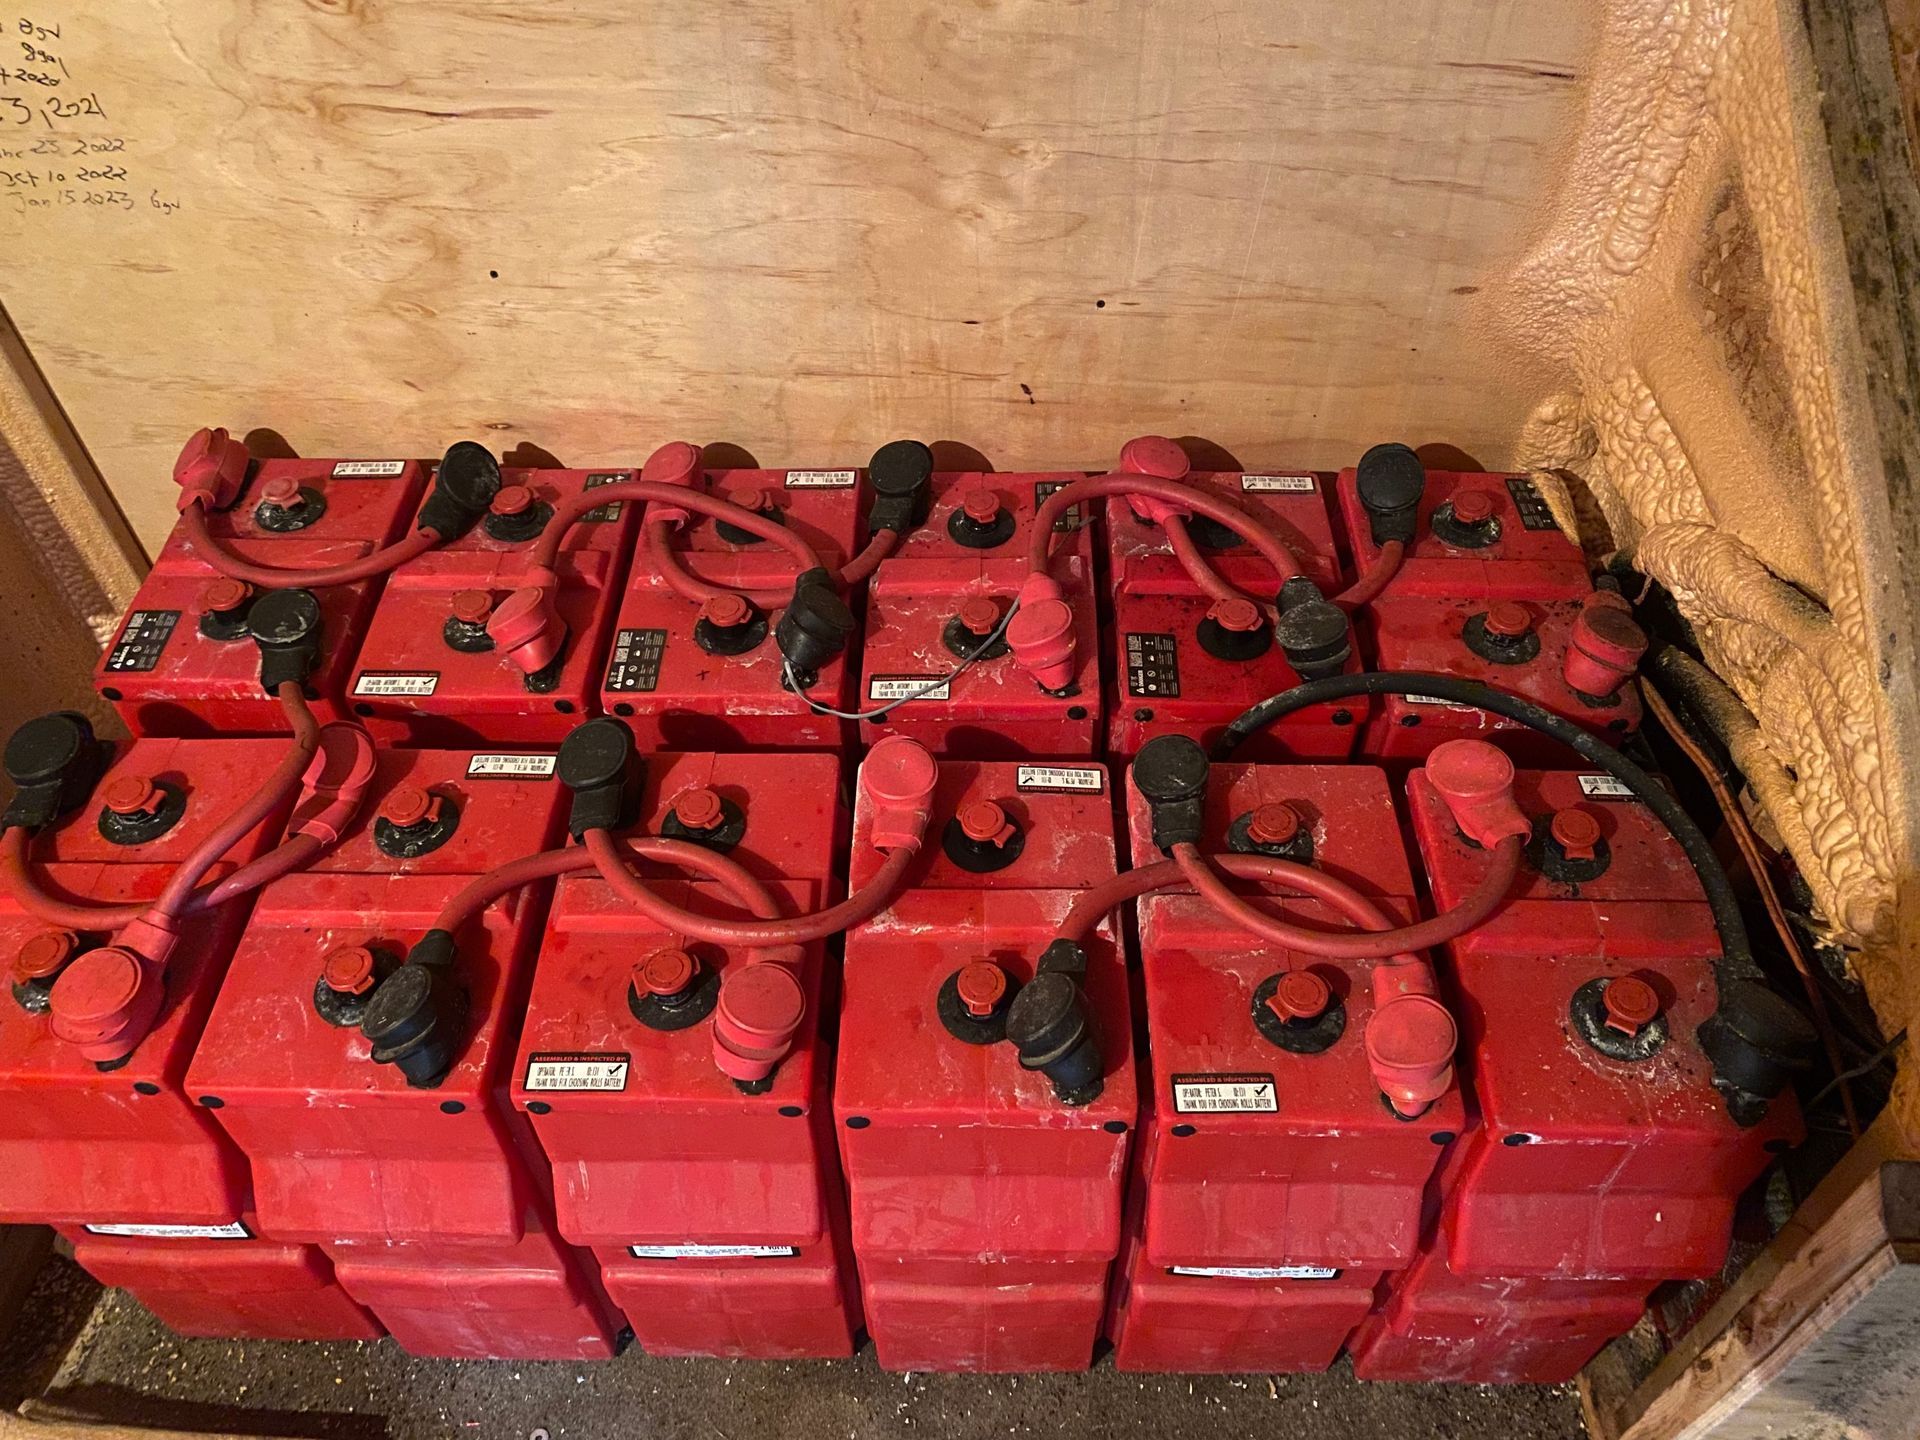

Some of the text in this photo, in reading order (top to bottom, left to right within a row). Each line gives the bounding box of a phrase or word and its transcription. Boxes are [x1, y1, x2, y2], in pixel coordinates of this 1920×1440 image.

[535, 1078, 622, 1088] THANK YOU FOR CHOOSING ROLLS BATTERY
[1183, 1099, 1272, 1109] THANK YOU FOR CHOOSING ROLLS BATTERY
